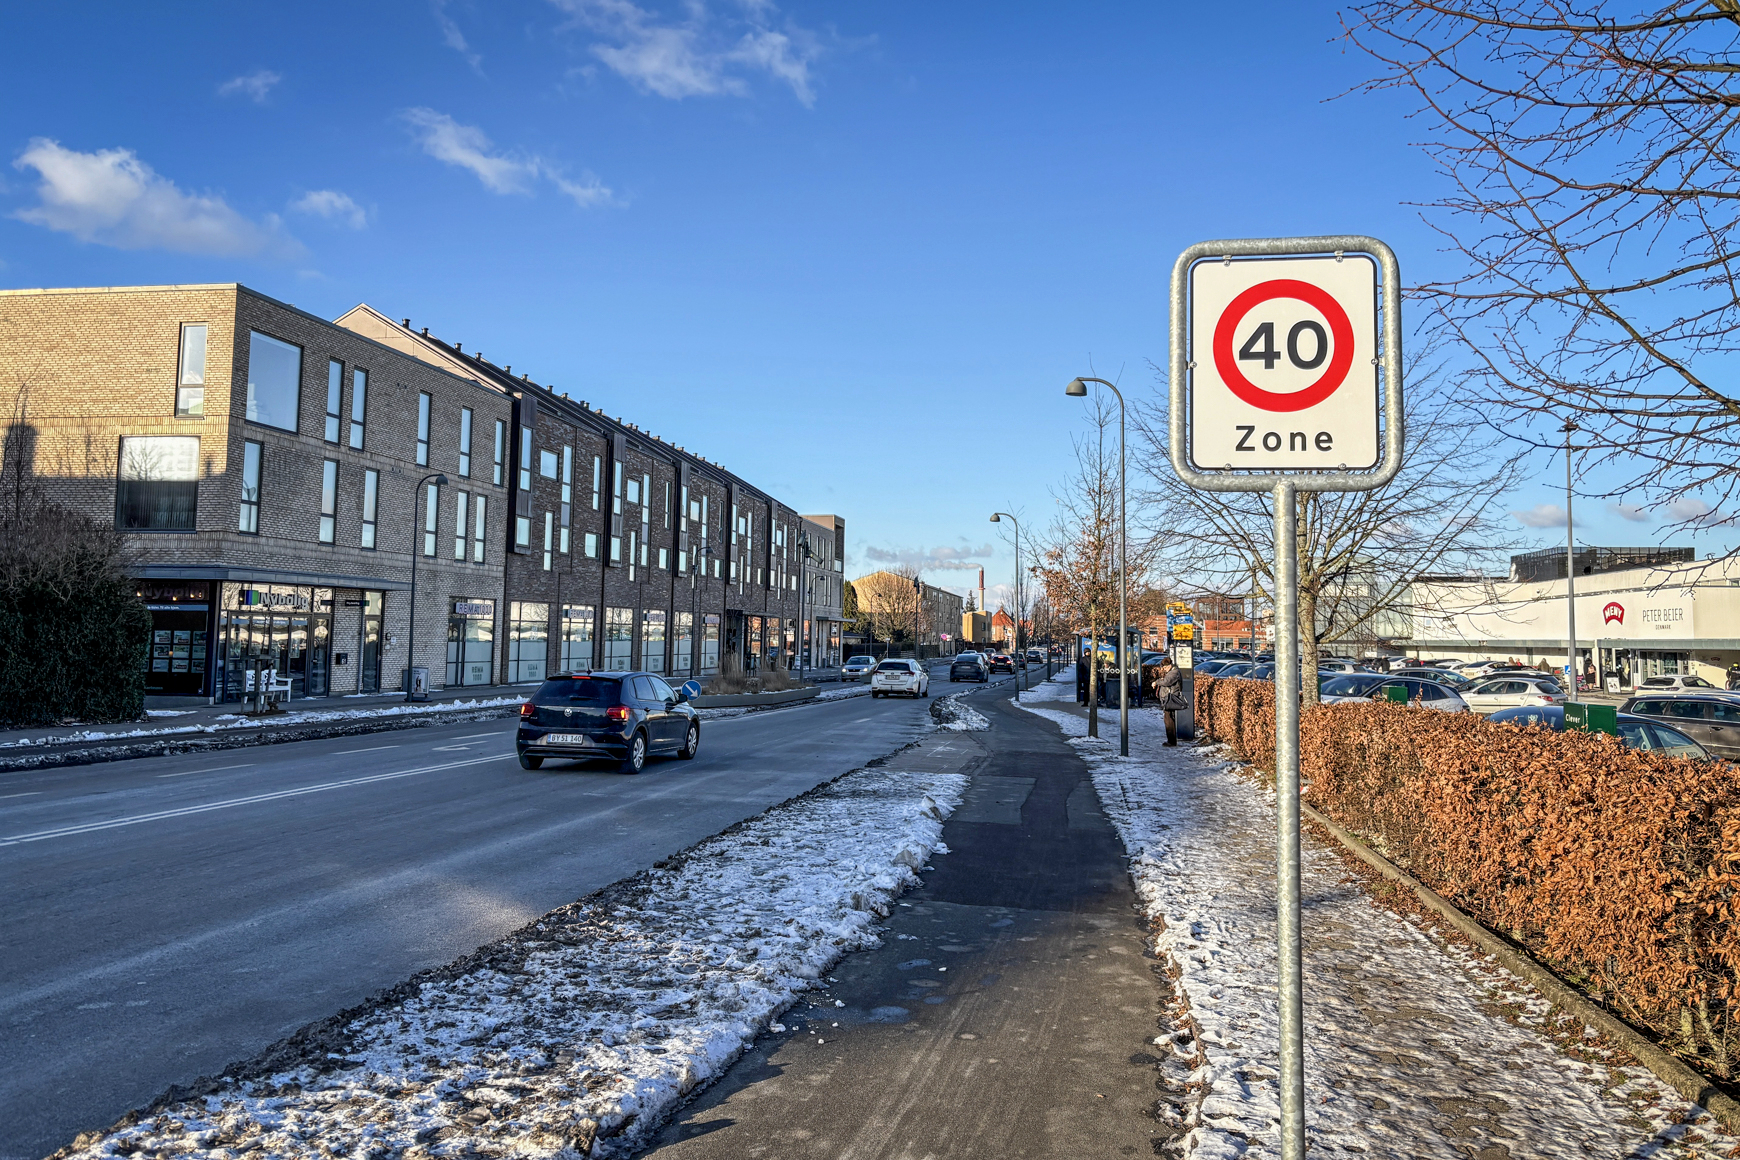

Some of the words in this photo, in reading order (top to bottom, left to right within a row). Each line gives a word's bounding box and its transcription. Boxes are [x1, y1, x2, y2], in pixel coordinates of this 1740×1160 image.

[1238, 320, 1328, 370] 40
[1235, 425, 1333, 451] Zone
[260, 591, 308, 610] Nybolig
[1605, 606, 1622, 619] MENY
[1642, 609, 1662, 622] PETER
[1664, 608, 1684, 622] BEIER
[1565, 714, 1580, 724] Clever
